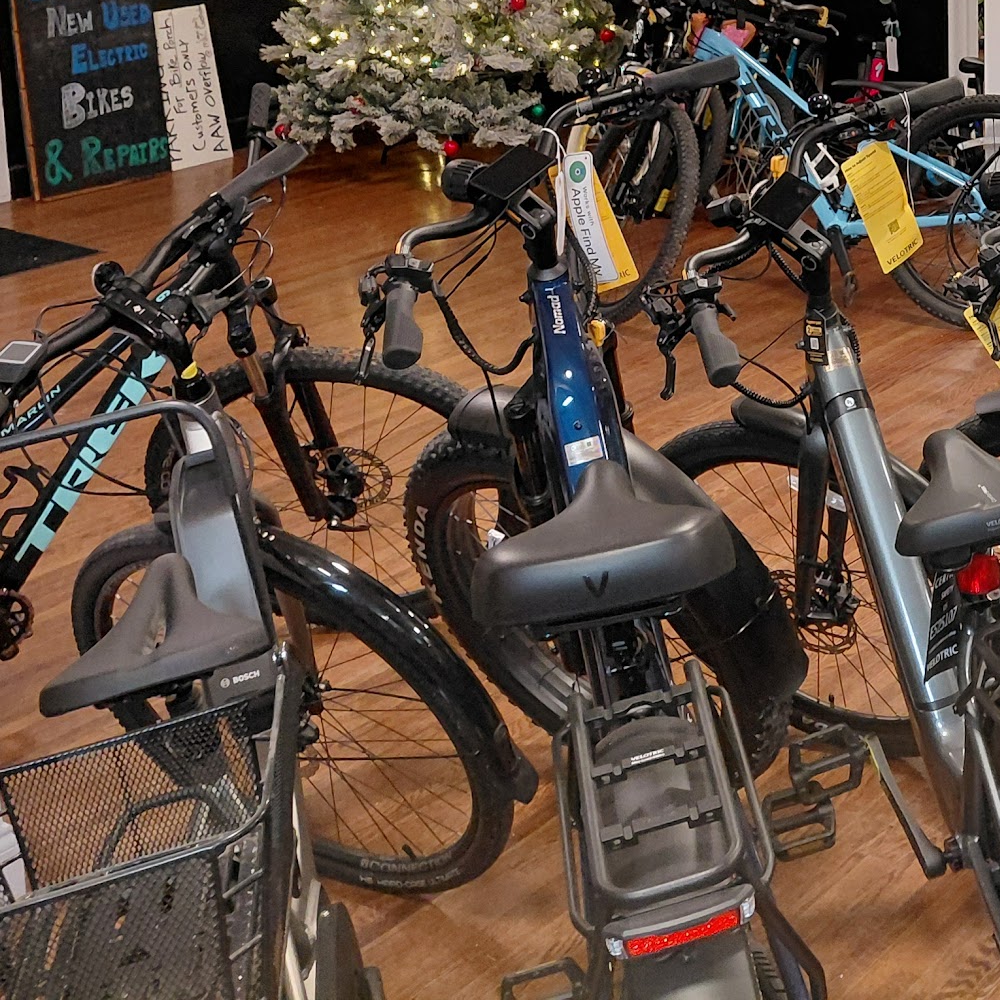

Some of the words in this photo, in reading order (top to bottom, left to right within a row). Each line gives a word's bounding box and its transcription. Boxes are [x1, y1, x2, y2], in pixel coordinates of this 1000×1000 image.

[46, 5, 94, 38] NEW
[101, 1, 151, 30] USED
[71, 42, 149, 75] ELECTRIC
[61, 82, 134, 130] BIKES
[44, 138, 72, 186] &
[81, 135, 168, 178] REPAIRS
[571, 188, 586, 226] Apple
[581, 228, 595, 255] Find
[886, 238, 918, 266] VELOTRIC
[547, 294, 567, 335] Nomad
[1, 384, 61, 438] MARLIN
[14, 350, 167, 563] TREK
[232, 669, 260, 685] BOSCH
